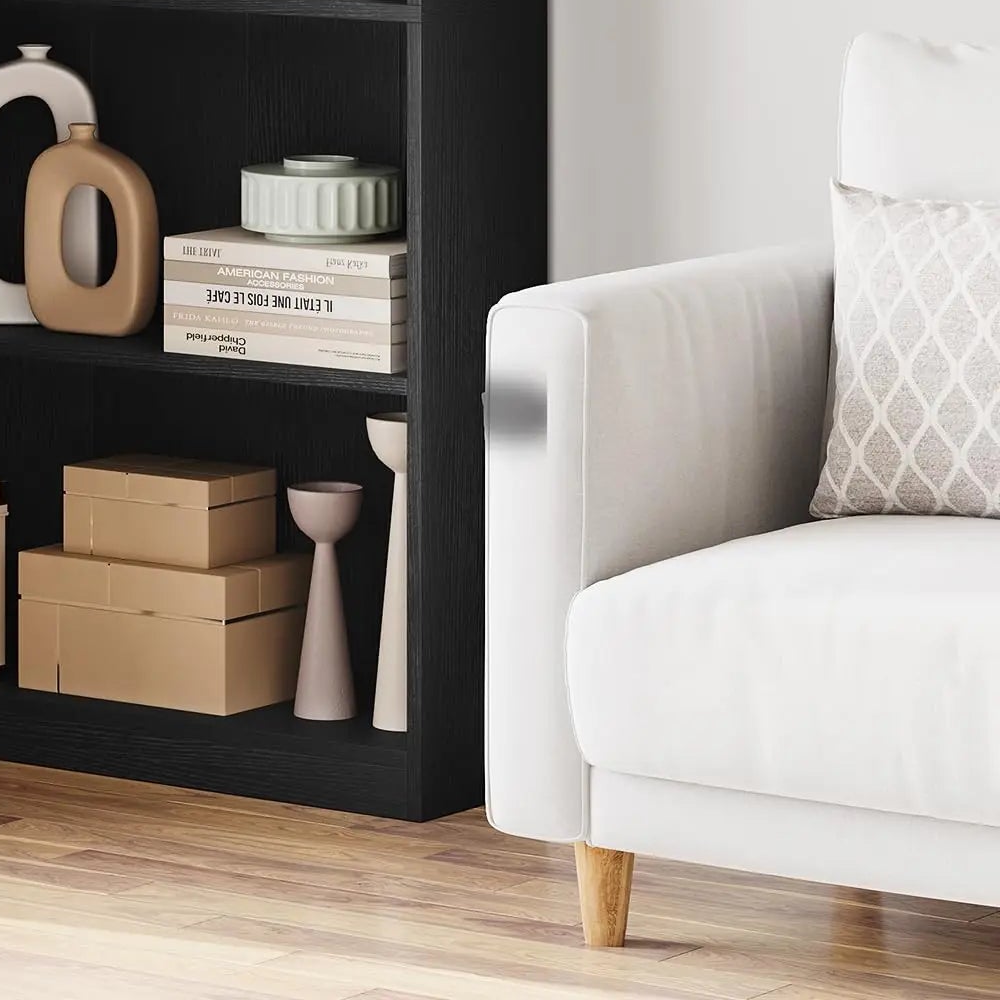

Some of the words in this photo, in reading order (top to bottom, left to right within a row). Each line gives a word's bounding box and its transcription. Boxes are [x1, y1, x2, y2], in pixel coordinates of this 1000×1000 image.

[217, 267, 280, 281] AMERICAN
[283, 272, 335, 286] FASHION
[246, 279, 305, 291] ACCESSORIES
[206, 289, 231, 304] CAFÉ
[233, 292, 245, 305] LE
[247, 293, 269, 307] FOIS
[271, 295, 291, 309] UNE
[294, 297, 321, 314] ÉTAIT
[324, 300, 334, 313] IL
[186, 332, 246, 346] Chipperfield
[218, 344, 246, 355] David
